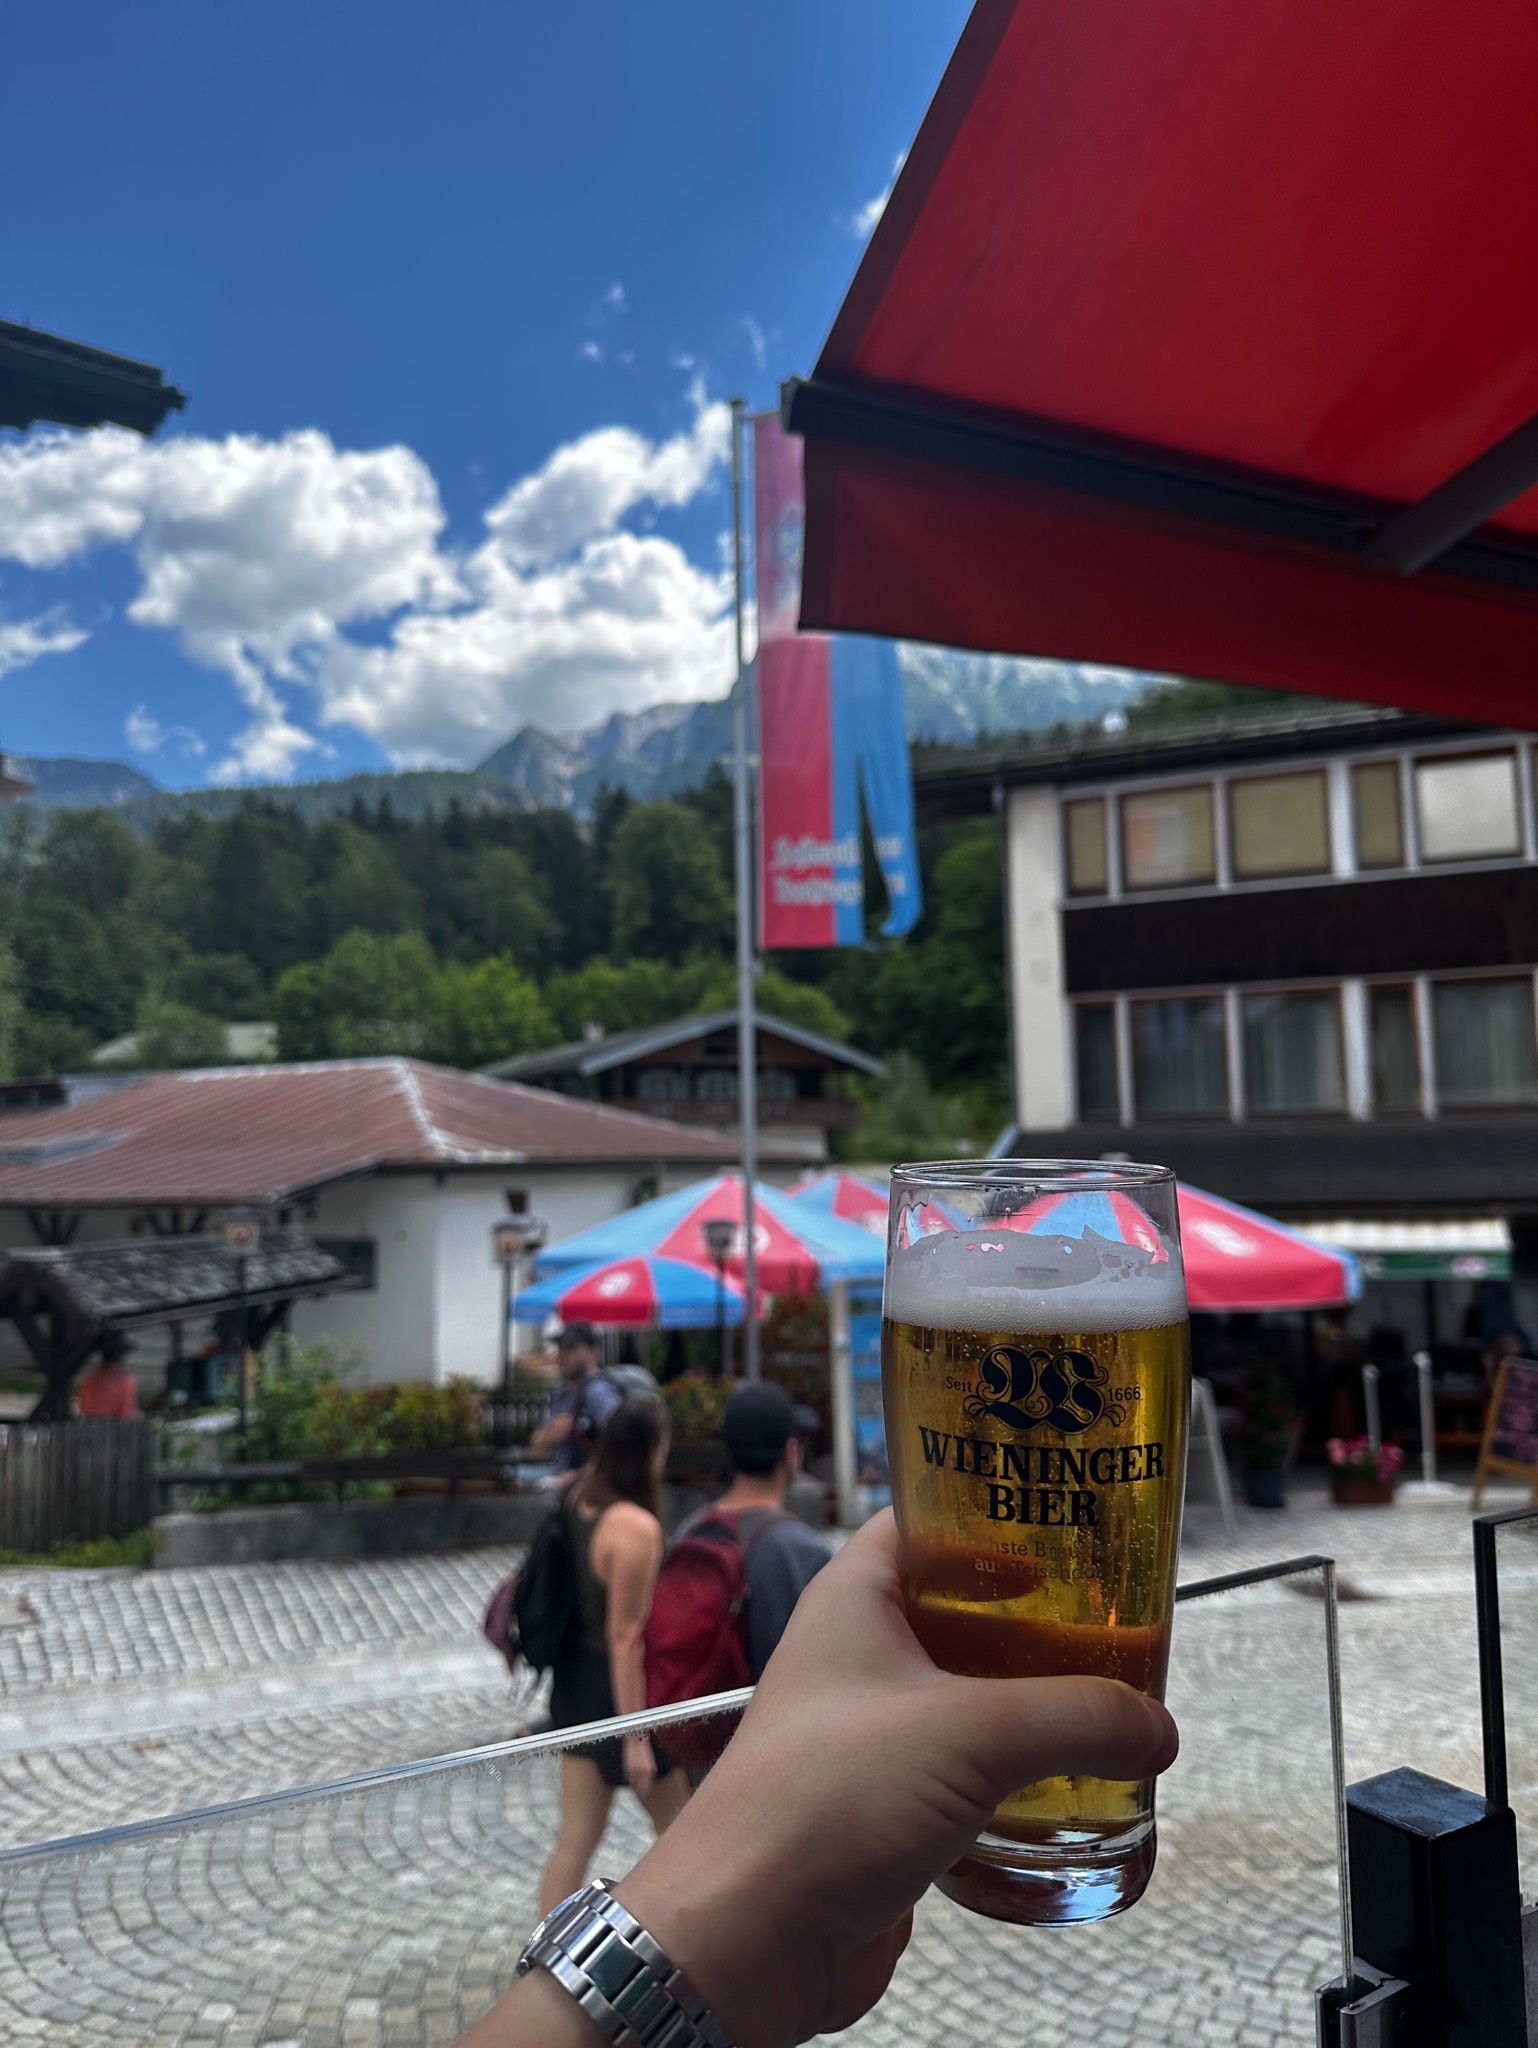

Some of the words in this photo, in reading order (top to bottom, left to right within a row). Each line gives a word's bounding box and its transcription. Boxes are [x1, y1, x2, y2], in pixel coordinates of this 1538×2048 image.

[945, 1376, 973, 1393] Seit
[1107, 1386, 1141, 1401] 1666
[918, 1425, 1165, 1485] WIENINGER
[986, 1483, 1100, 1527] BIER
